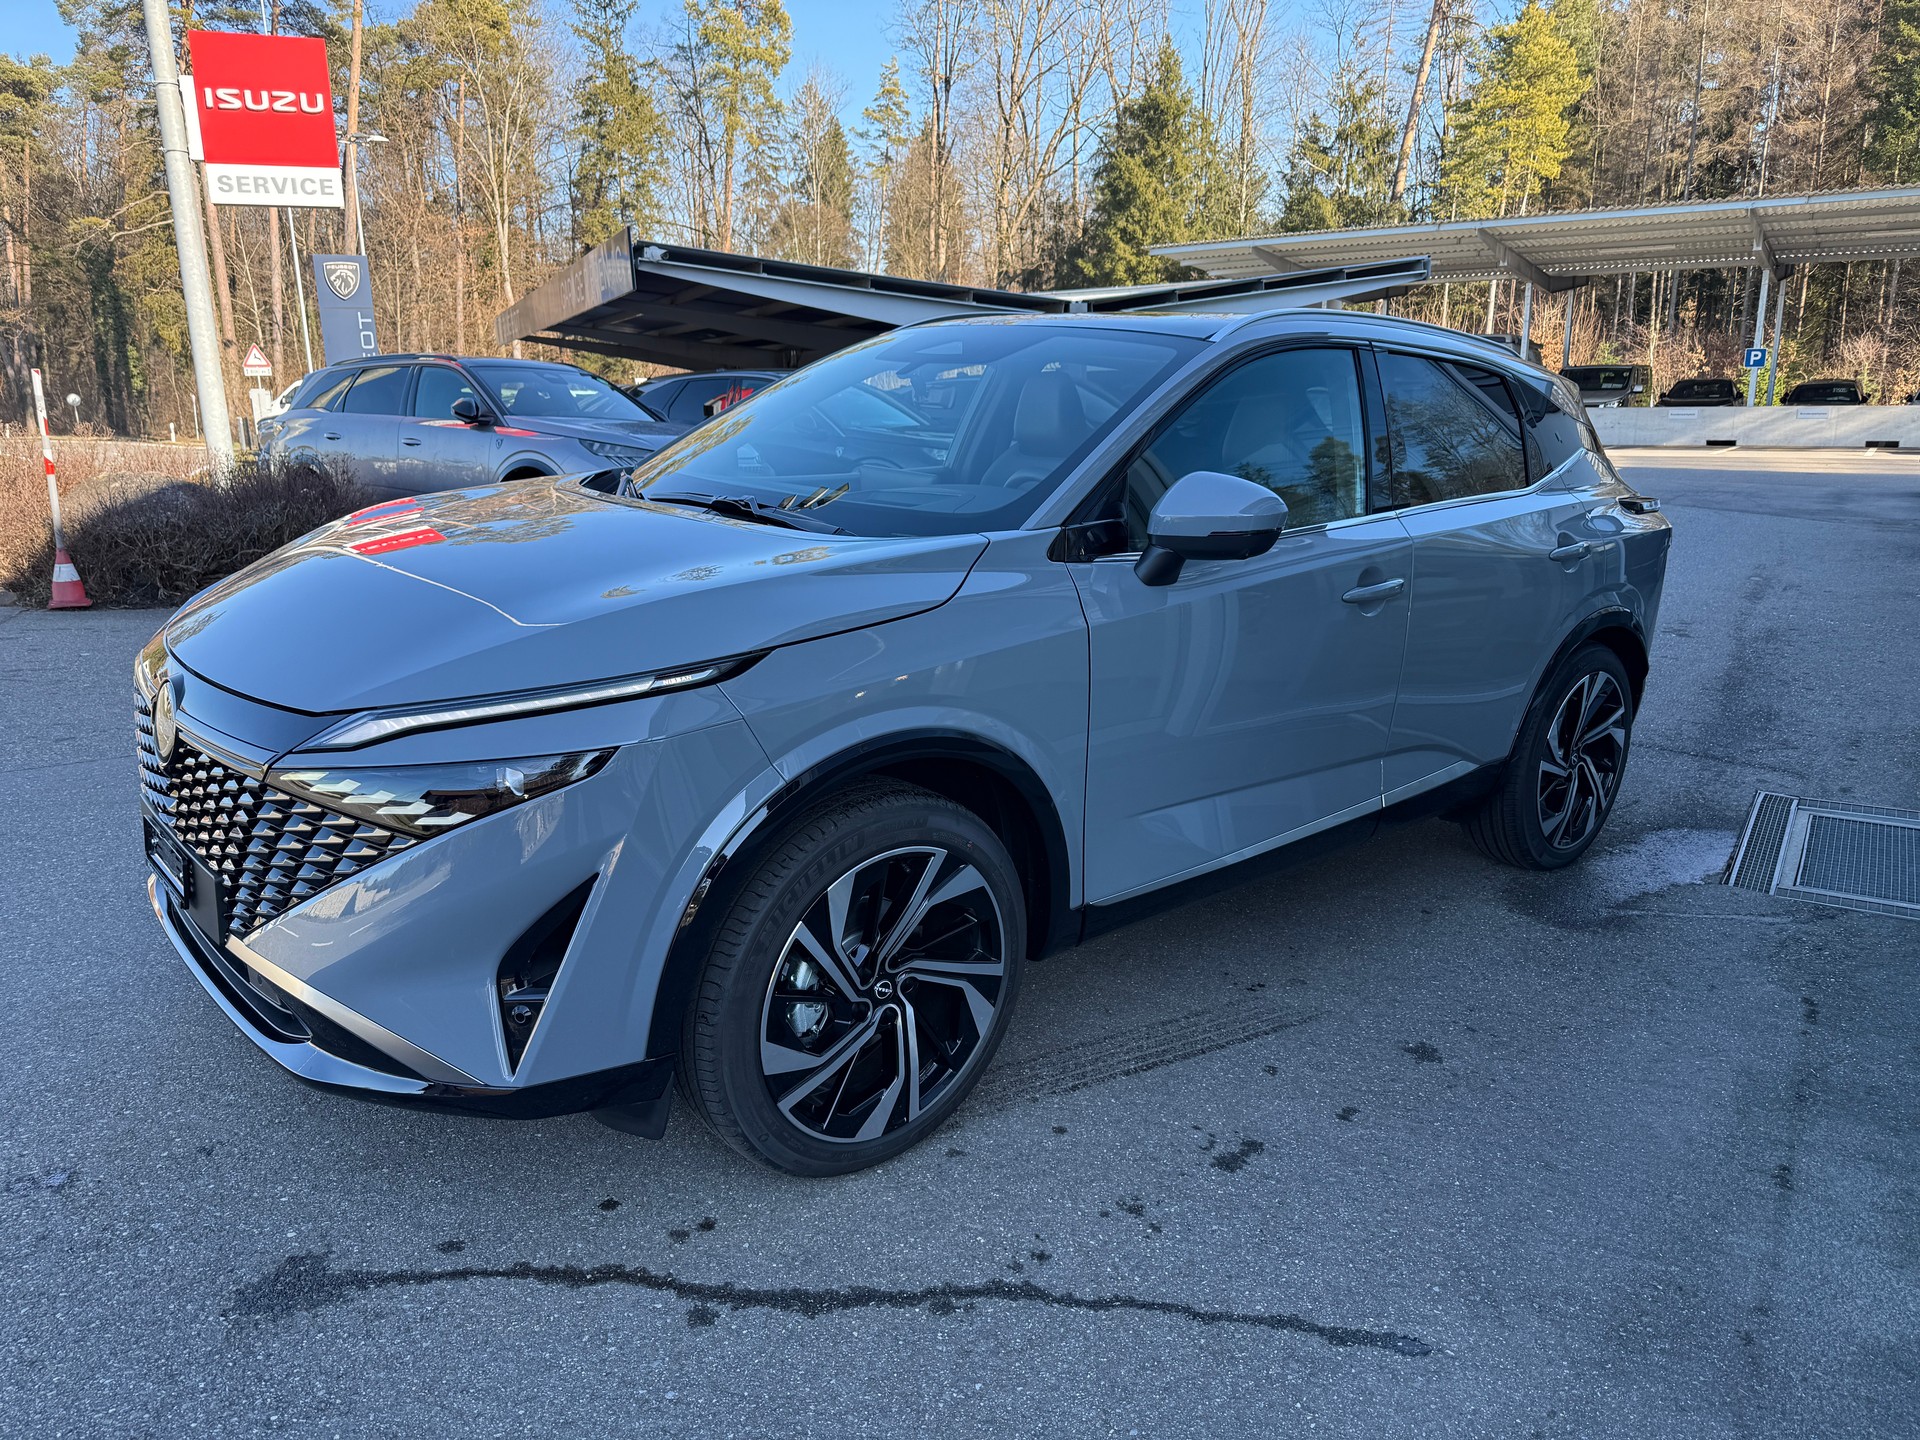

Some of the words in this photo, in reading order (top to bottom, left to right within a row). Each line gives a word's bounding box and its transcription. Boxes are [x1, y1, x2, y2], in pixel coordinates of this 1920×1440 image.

[204, 87, 324, 114] ISUZU
[217, 175, 335, 196] SERVICE
[1750, 351, 1762, 365] P
